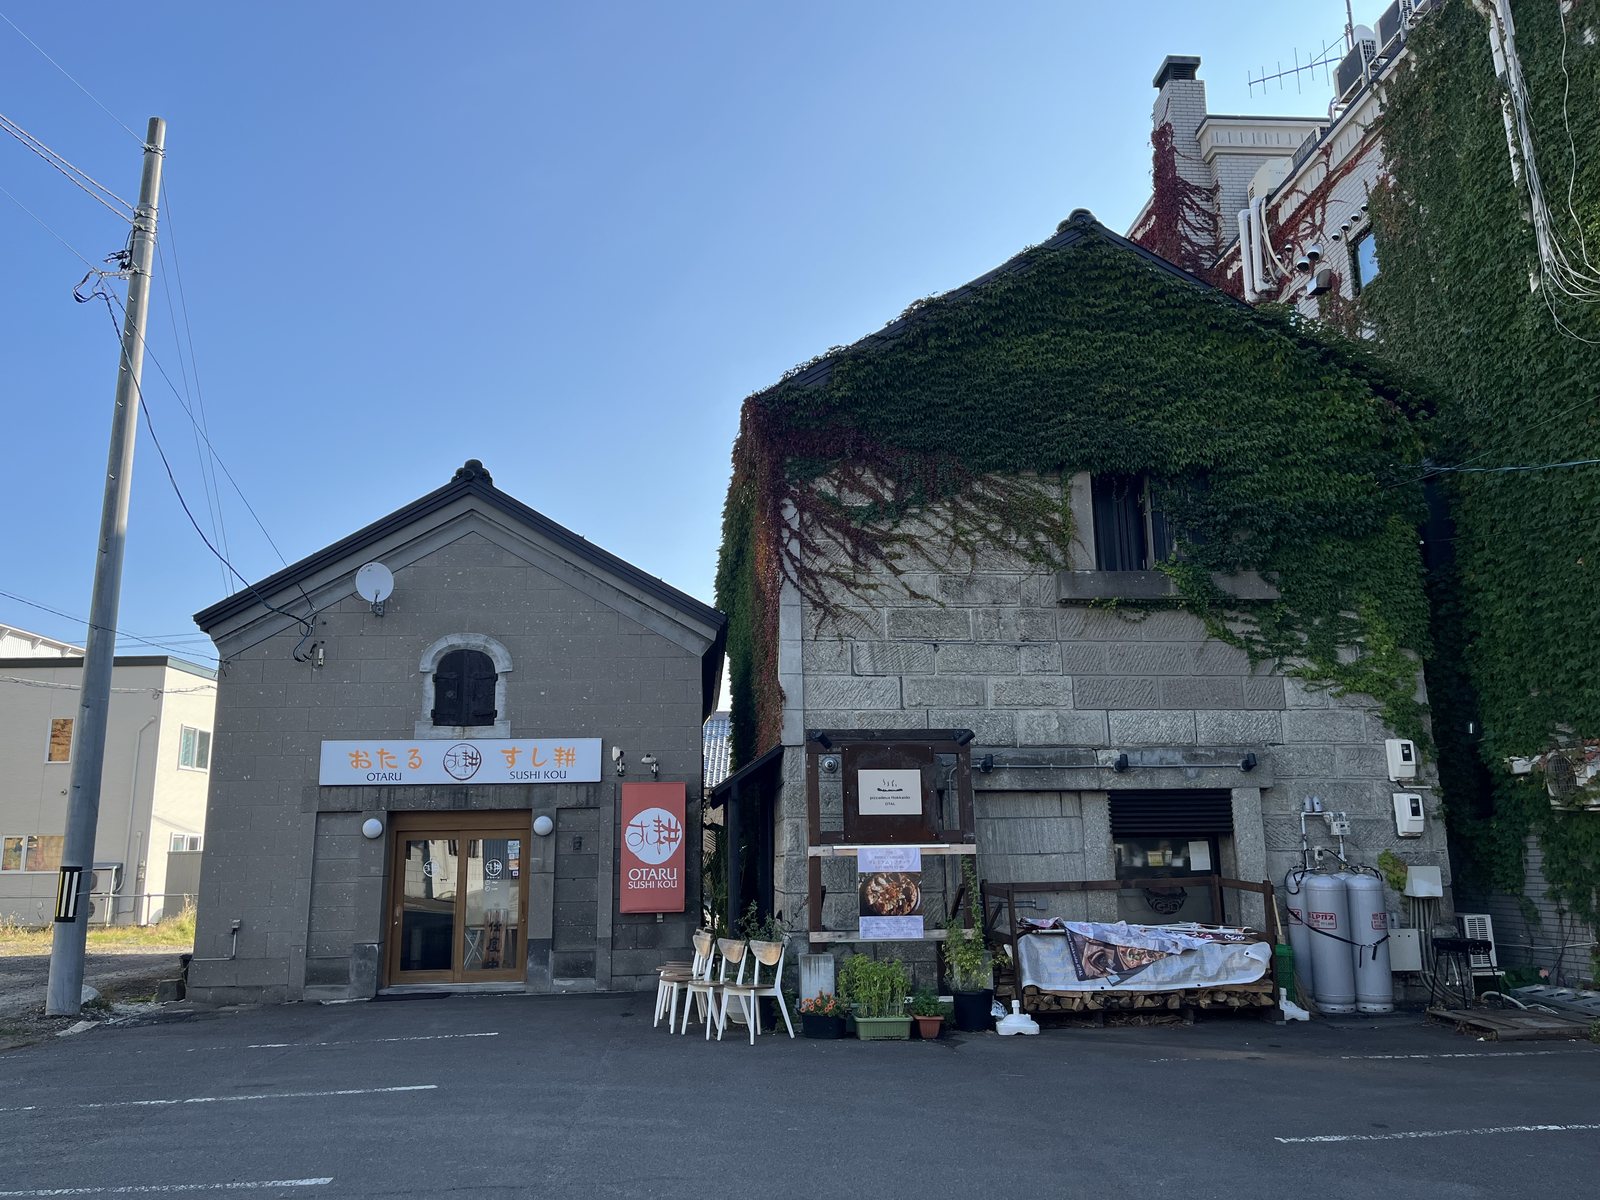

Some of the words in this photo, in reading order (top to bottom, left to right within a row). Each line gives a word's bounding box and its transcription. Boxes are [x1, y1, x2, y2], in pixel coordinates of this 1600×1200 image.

[347, 748, 423, 770] おたる
[500, 746, 576, 768] すし耕
[366, 772, 402, 782] OTARU
[509, 770, 540, 780] SUSHI
[543, 769, 567, 780] KOU
[628, 868, 678, 881] OTARU
[628, 880, 655, 889] SUSHI
[657, 880, 678, 889] KOU
